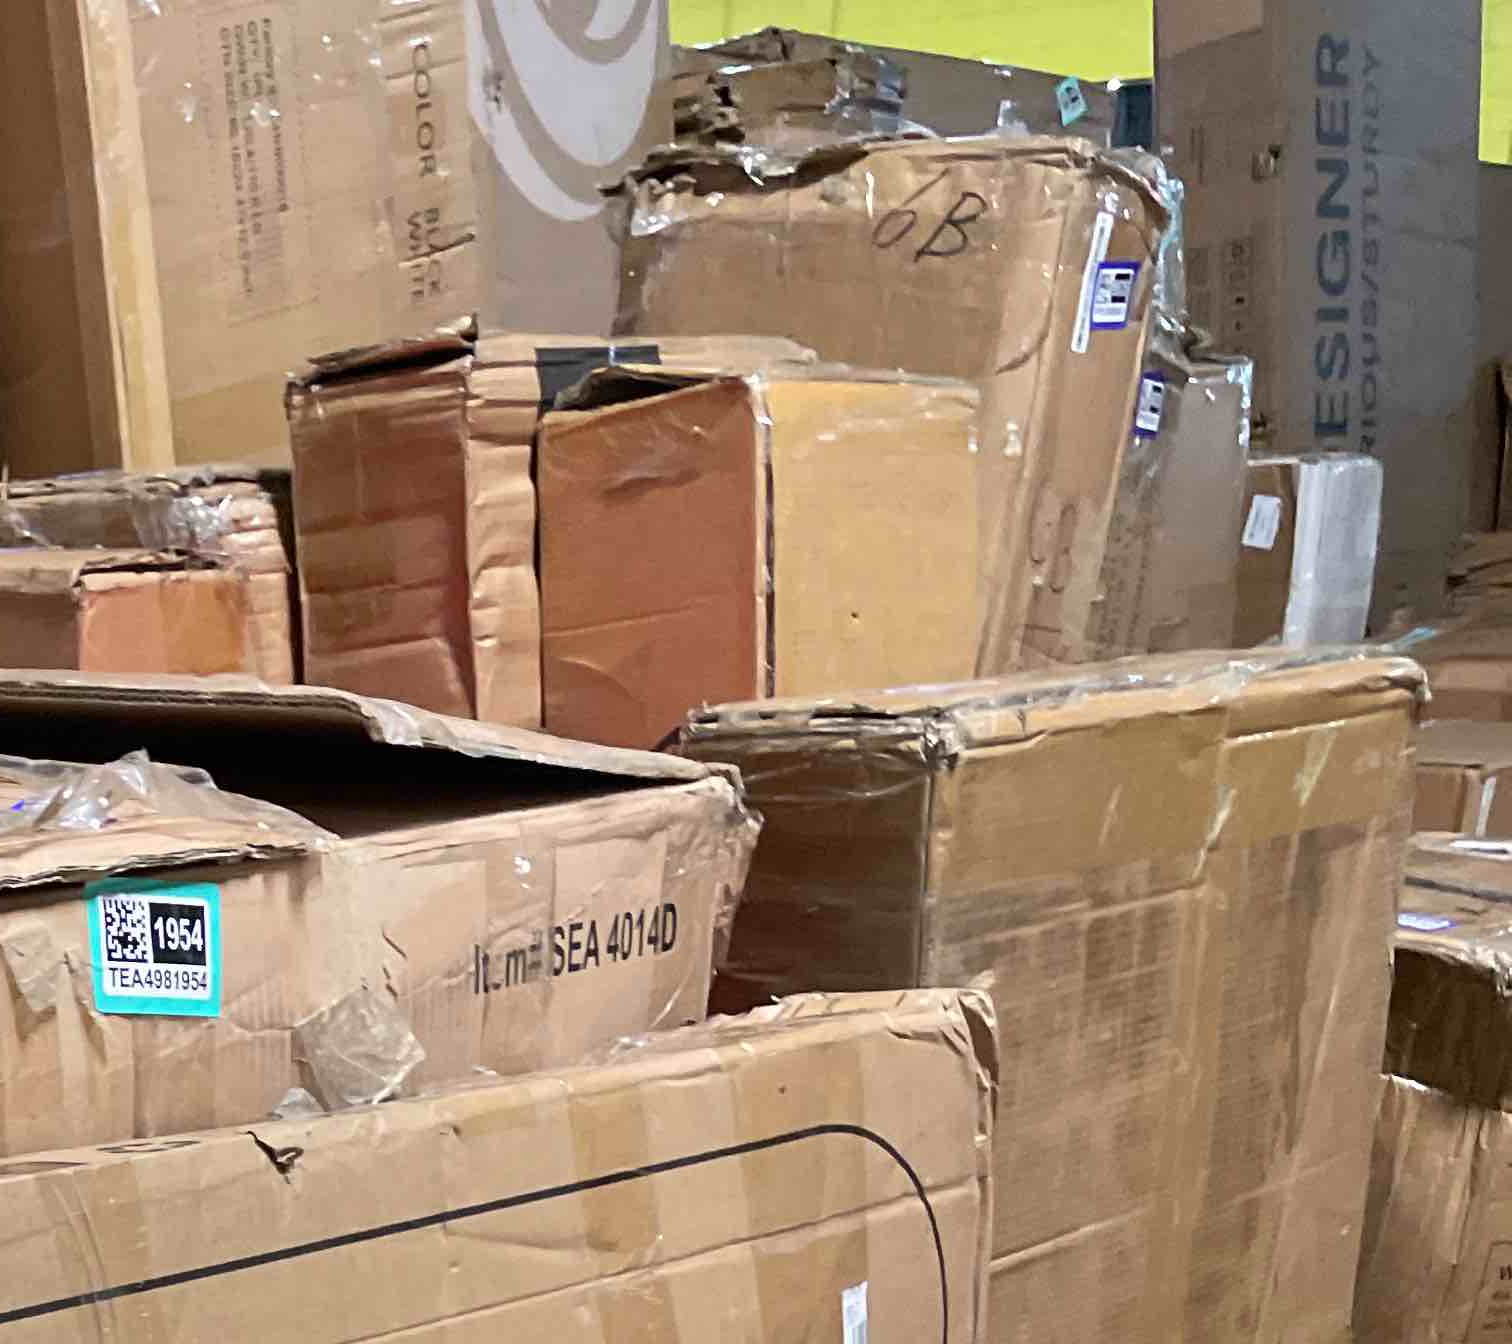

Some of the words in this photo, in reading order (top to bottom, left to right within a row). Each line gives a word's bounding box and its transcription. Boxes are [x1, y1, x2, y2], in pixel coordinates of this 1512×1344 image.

[412, 43, 437, 177] COLOR
[1314, 33, 1351, 450] ESIGNER
[1359, 45, 1381, 453] RIOUS/STURDY
[108, 967, 208, 991] TEA4981954
[153, 916, 204, 952] 1954
[552, 919, 600, 977] SEA
[606, 902, 678, 963] 4014D
